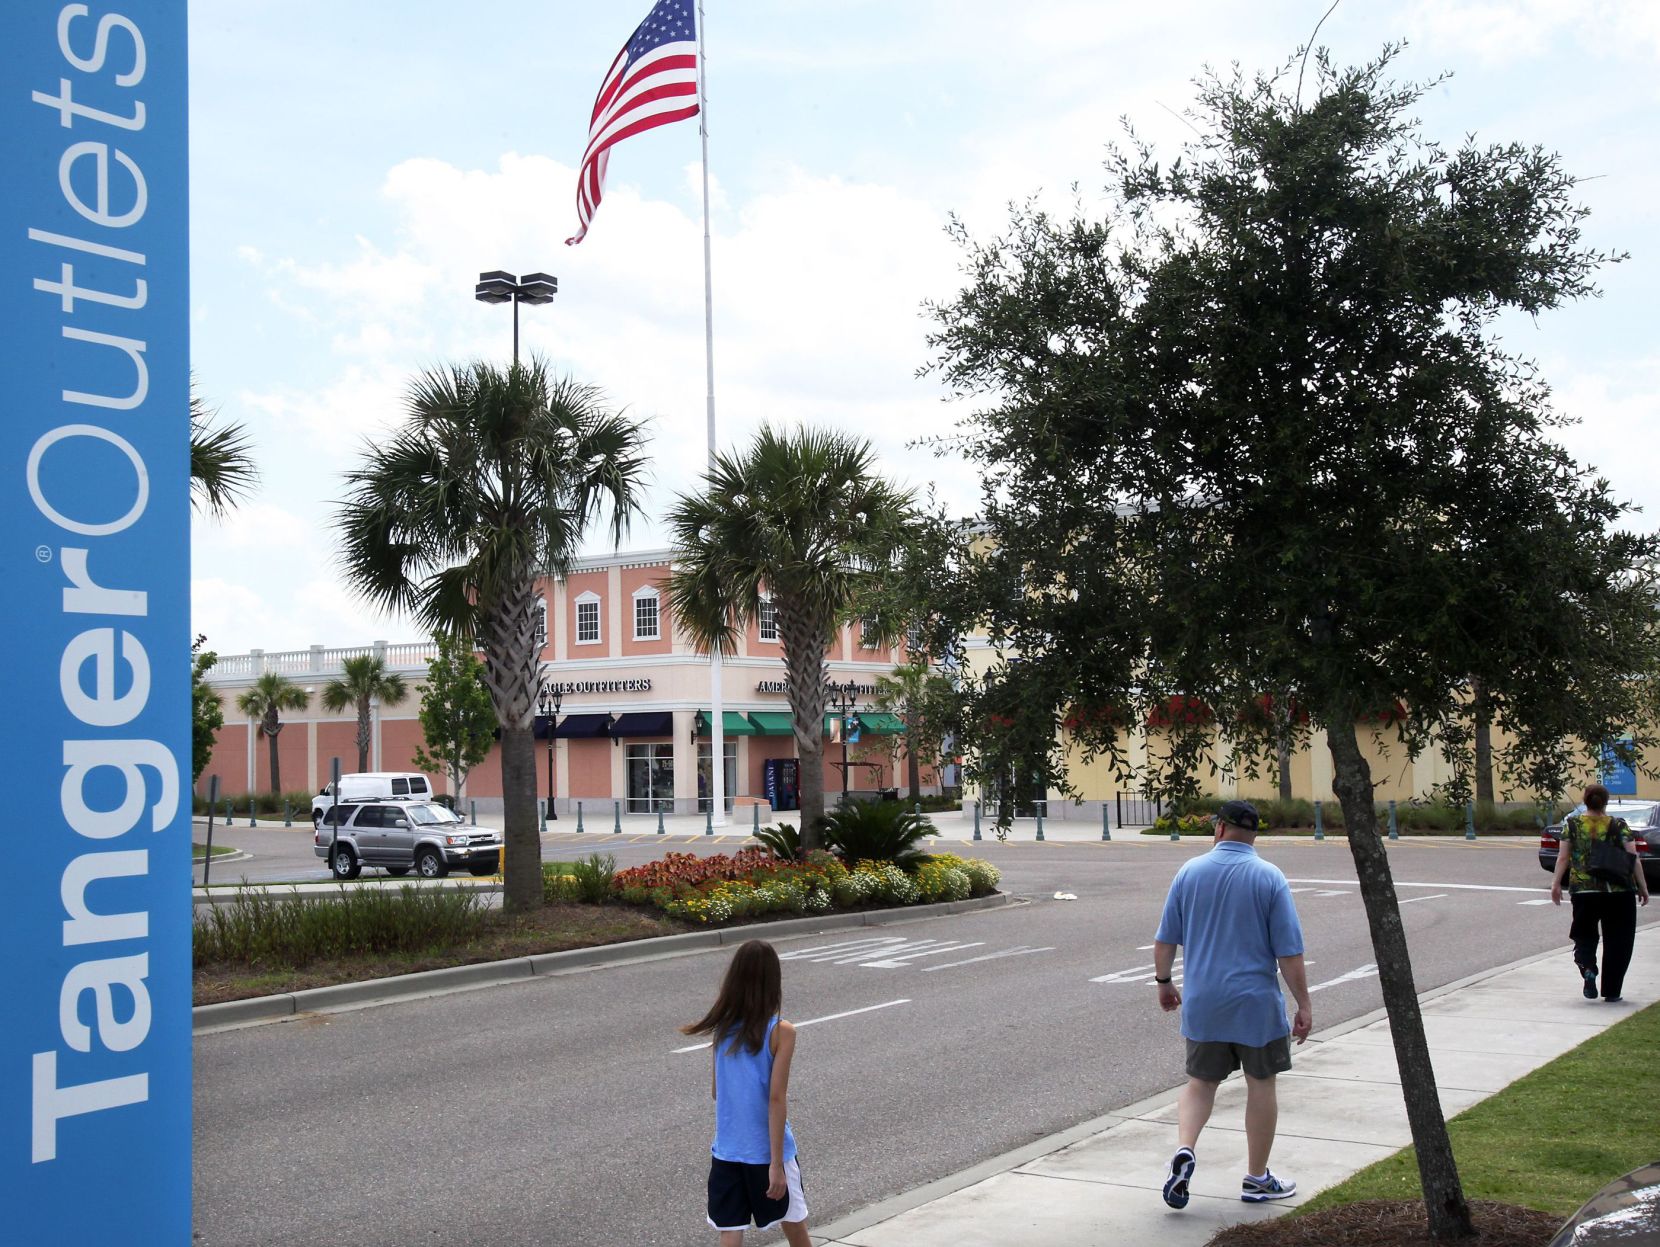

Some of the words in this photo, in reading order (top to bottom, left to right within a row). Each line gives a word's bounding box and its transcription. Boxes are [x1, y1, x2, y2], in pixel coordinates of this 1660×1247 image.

[543, 681, 574, 695] AGLE
[575, 678, 651, 693] OUTFITTERS
[778, 936, 1057, 972] ONLY
